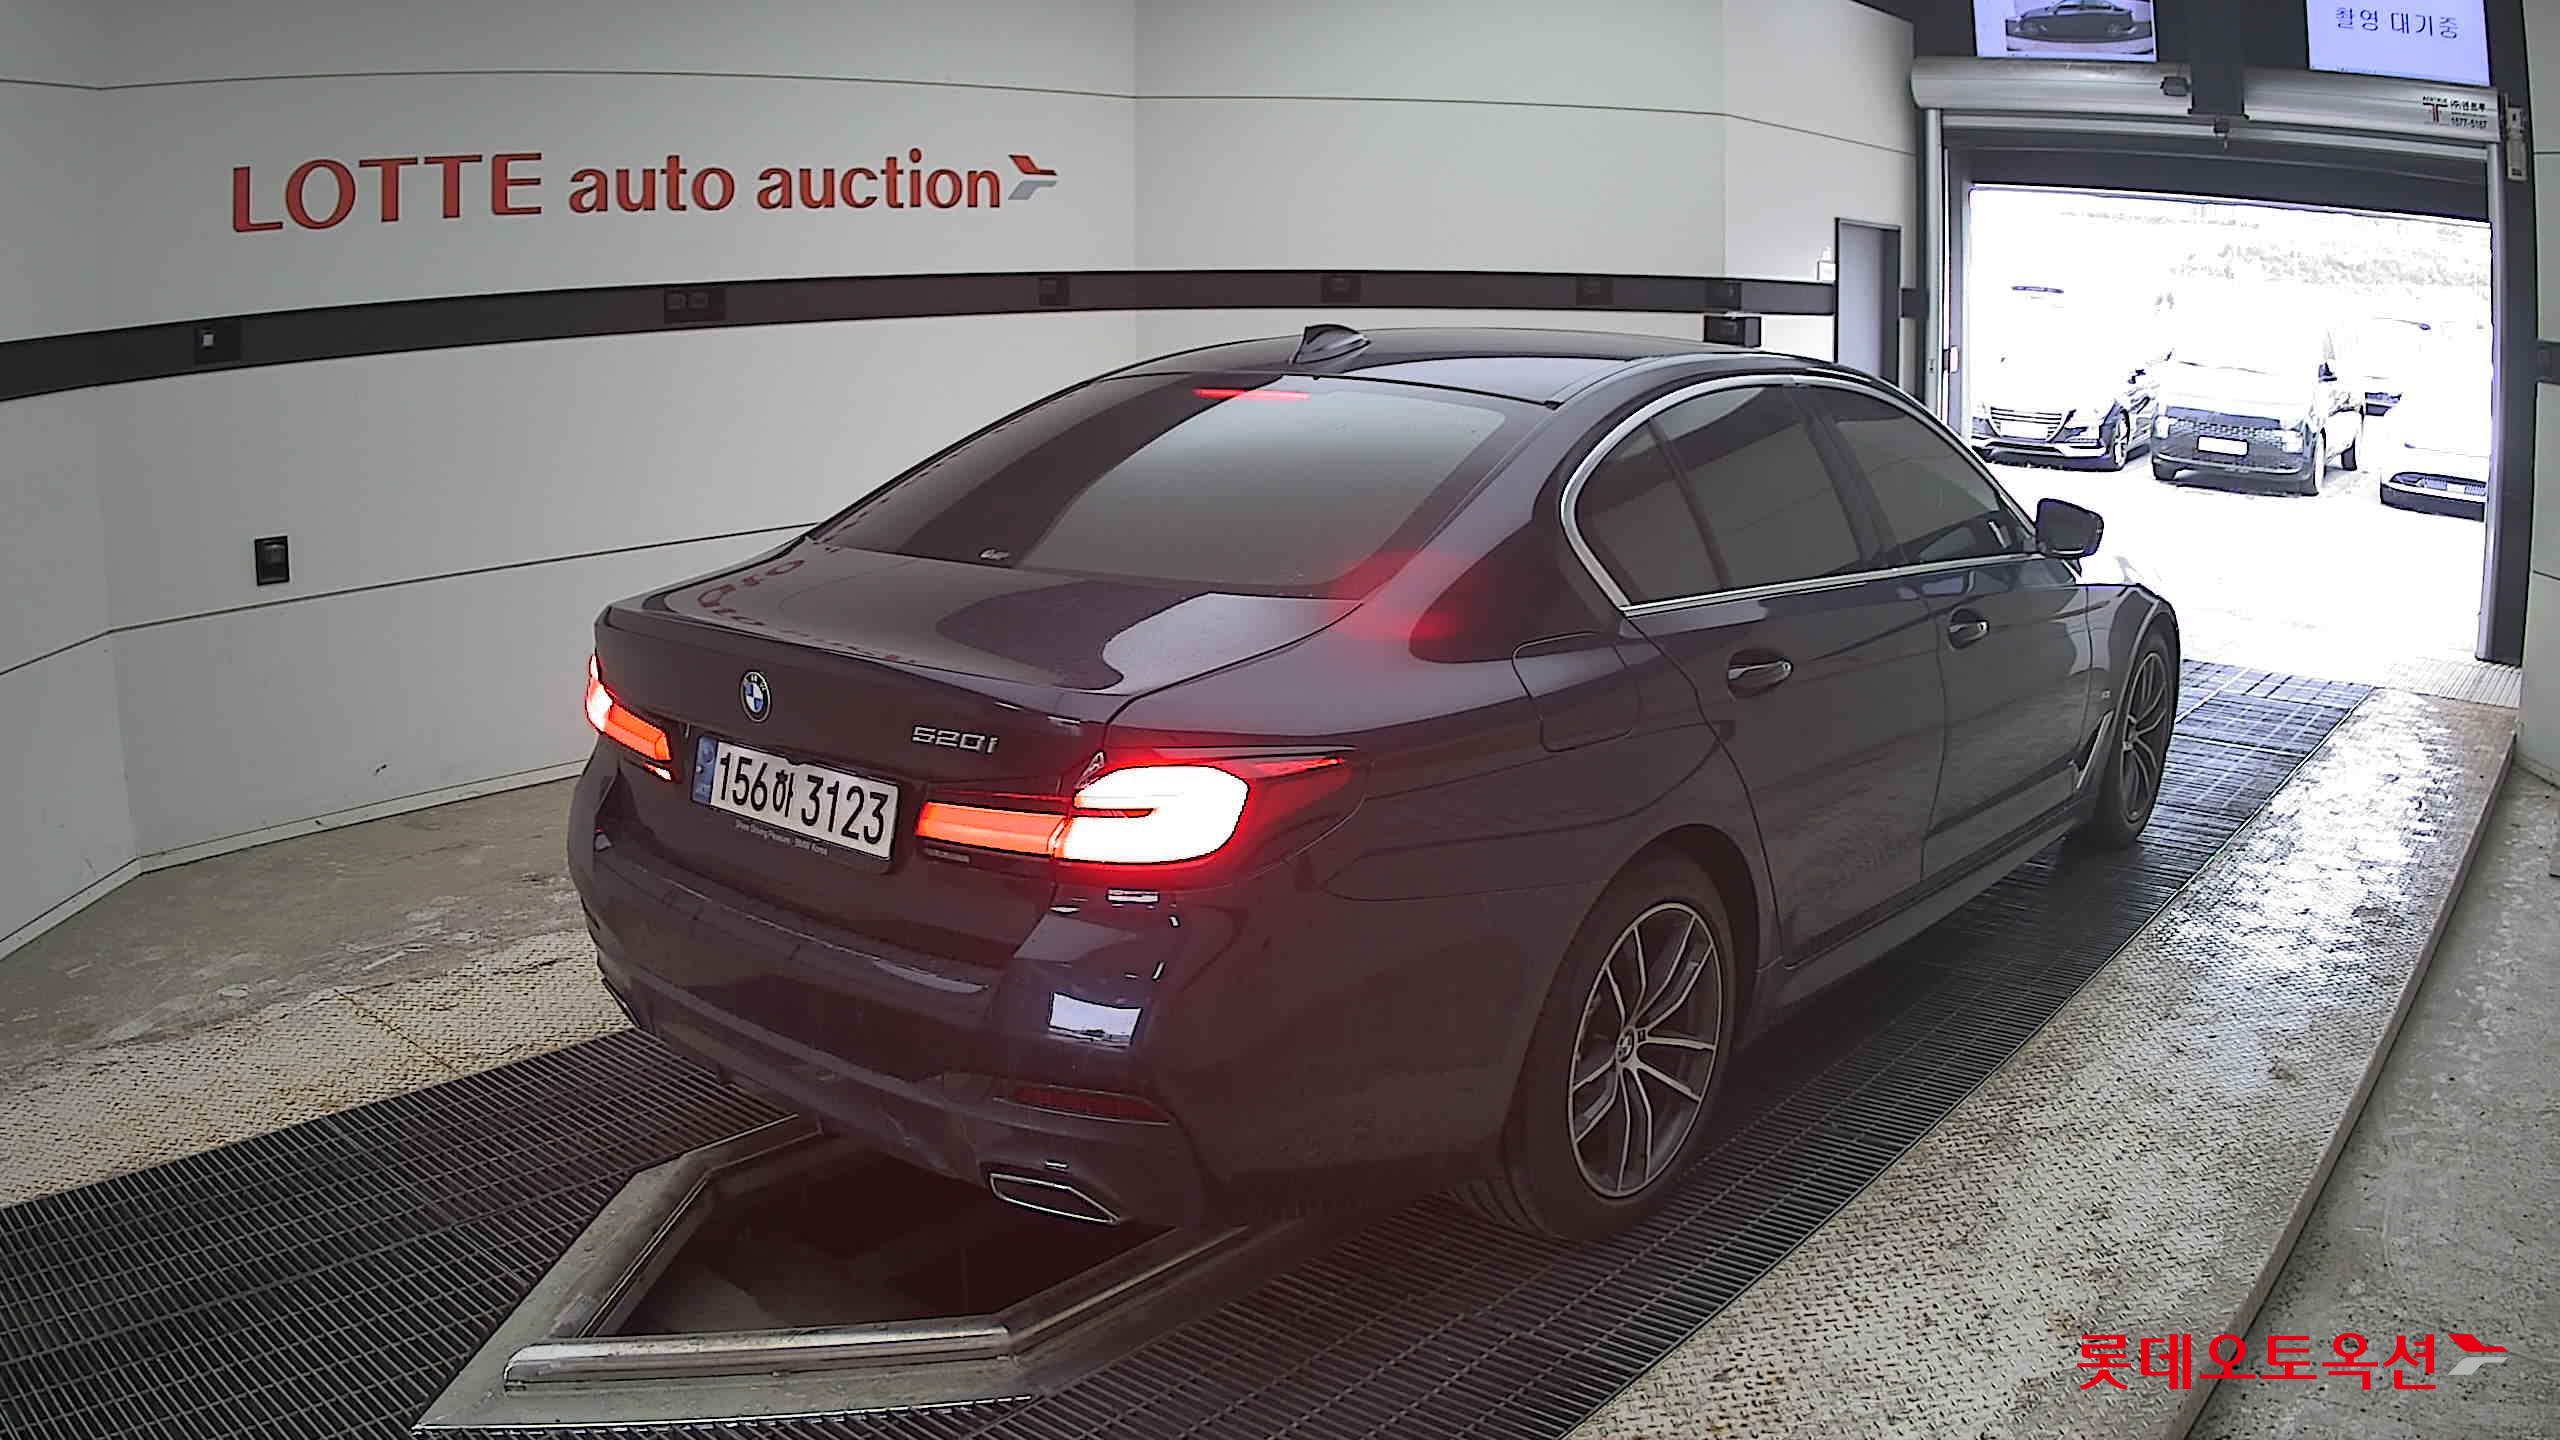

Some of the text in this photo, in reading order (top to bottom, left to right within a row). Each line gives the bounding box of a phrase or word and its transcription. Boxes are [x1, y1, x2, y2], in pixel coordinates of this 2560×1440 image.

[2335, 7, 2379, 31] 촬영
[232, 147, 1001, 233] LOTTE auto auction
[912, 726, 999, 753] 520i
[719, 751, 796, 818] 156하
[800, 773, 891, 845] 3123
